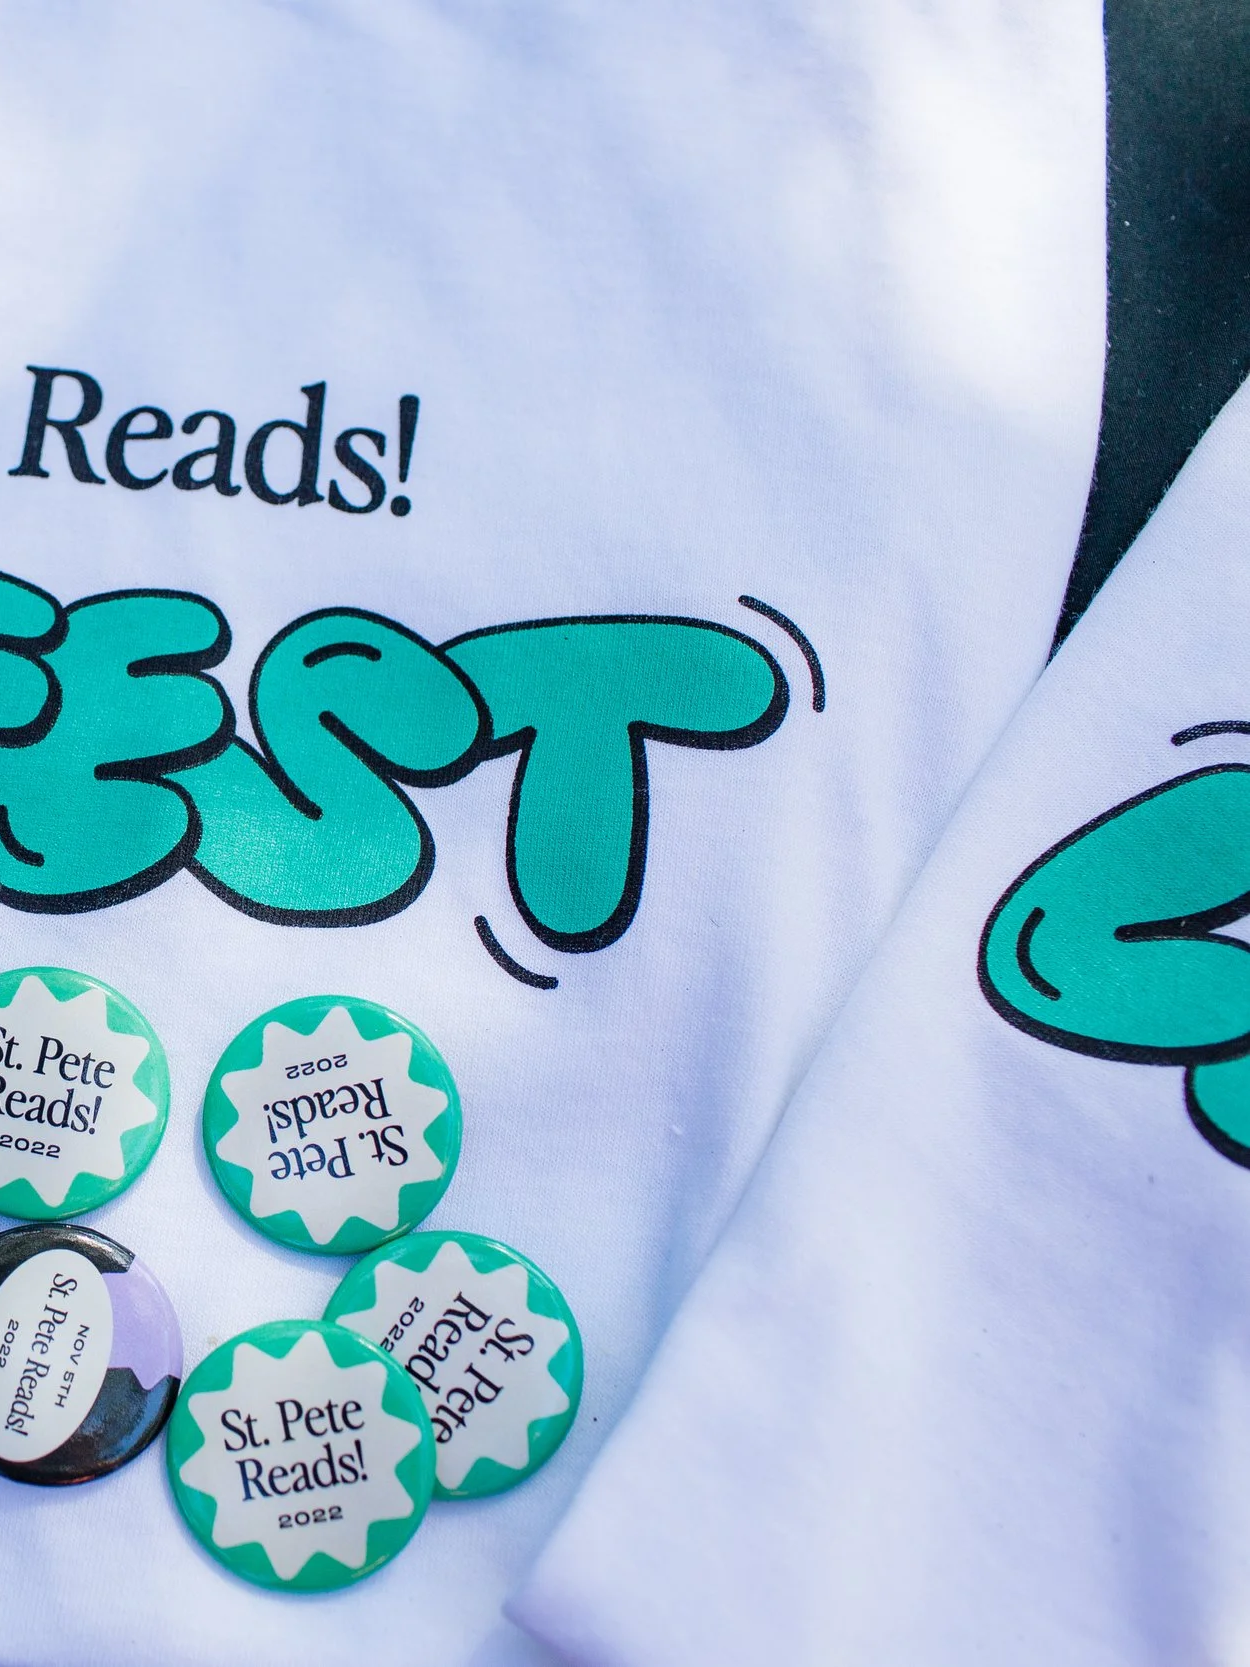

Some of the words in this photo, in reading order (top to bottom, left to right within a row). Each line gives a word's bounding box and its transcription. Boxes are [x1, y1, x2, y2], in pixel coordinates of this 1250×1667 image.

[8, 365, 419, 516] Reads!
[33, 1036, 115, 1088] Pete
[285, 1054, 348, 1079] 2022
[263, 1078, 392, 1143] Reads!
[268, 1137, 355, 1180] Pete
[358, 1125, 408, 1166] St.
[48, 1273, 77, 1298] St.
[32, 1304, 68, 1354] Pete
[70, 1324, 89, 1366] NOV
[380, 1297, 424, 1353] 2022
[405, 1291, 493, 1394] Read
[479, 1318, 534, 1363] St.
[5, 1358, 50, 1436] Reads!
[55, 1371, 74, 1408] 5TH
[430, 1363, 504, 1444] Pete
[220, 1409, 269, 1451] St.
[276, 1399, 365, 1442] Pete
[235, 1439, 368, 1501] Reads!
[278, 1506, 343, 1529] 2022
